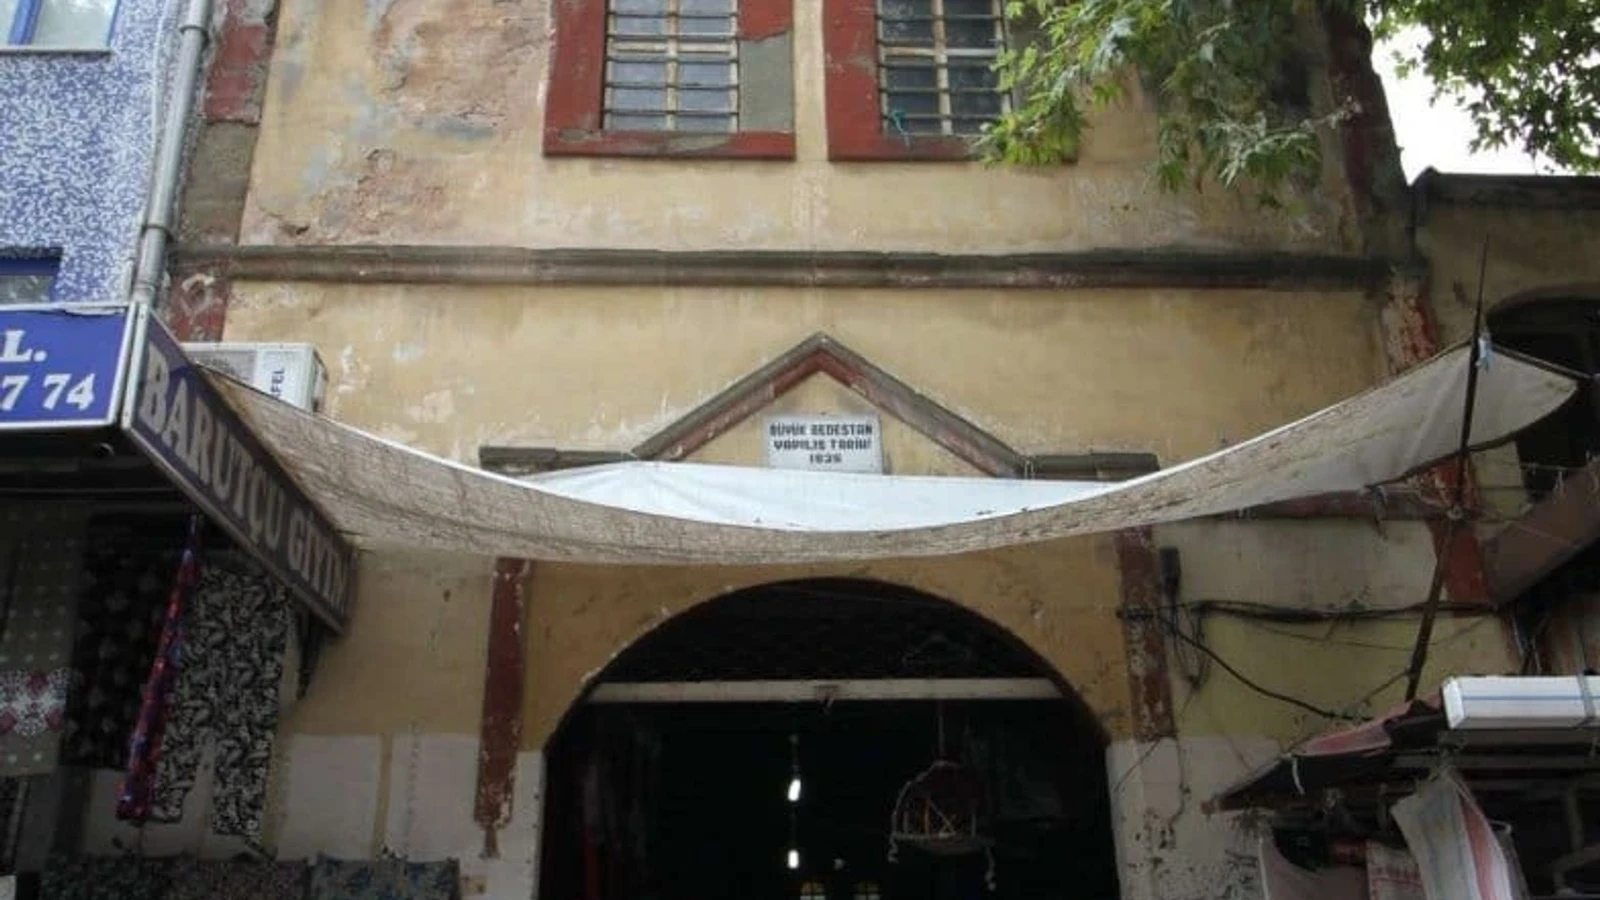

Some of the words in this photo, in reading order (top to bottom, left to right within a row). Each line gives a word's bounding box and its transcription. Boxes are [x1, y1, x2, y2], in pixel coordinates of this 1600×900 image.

[0, 375, 30, 411] 7
[42, 373, 96, 411] 74
[271, 368, 285, 398] FEL
[139, 341, 286, 549] BARUTÇU
